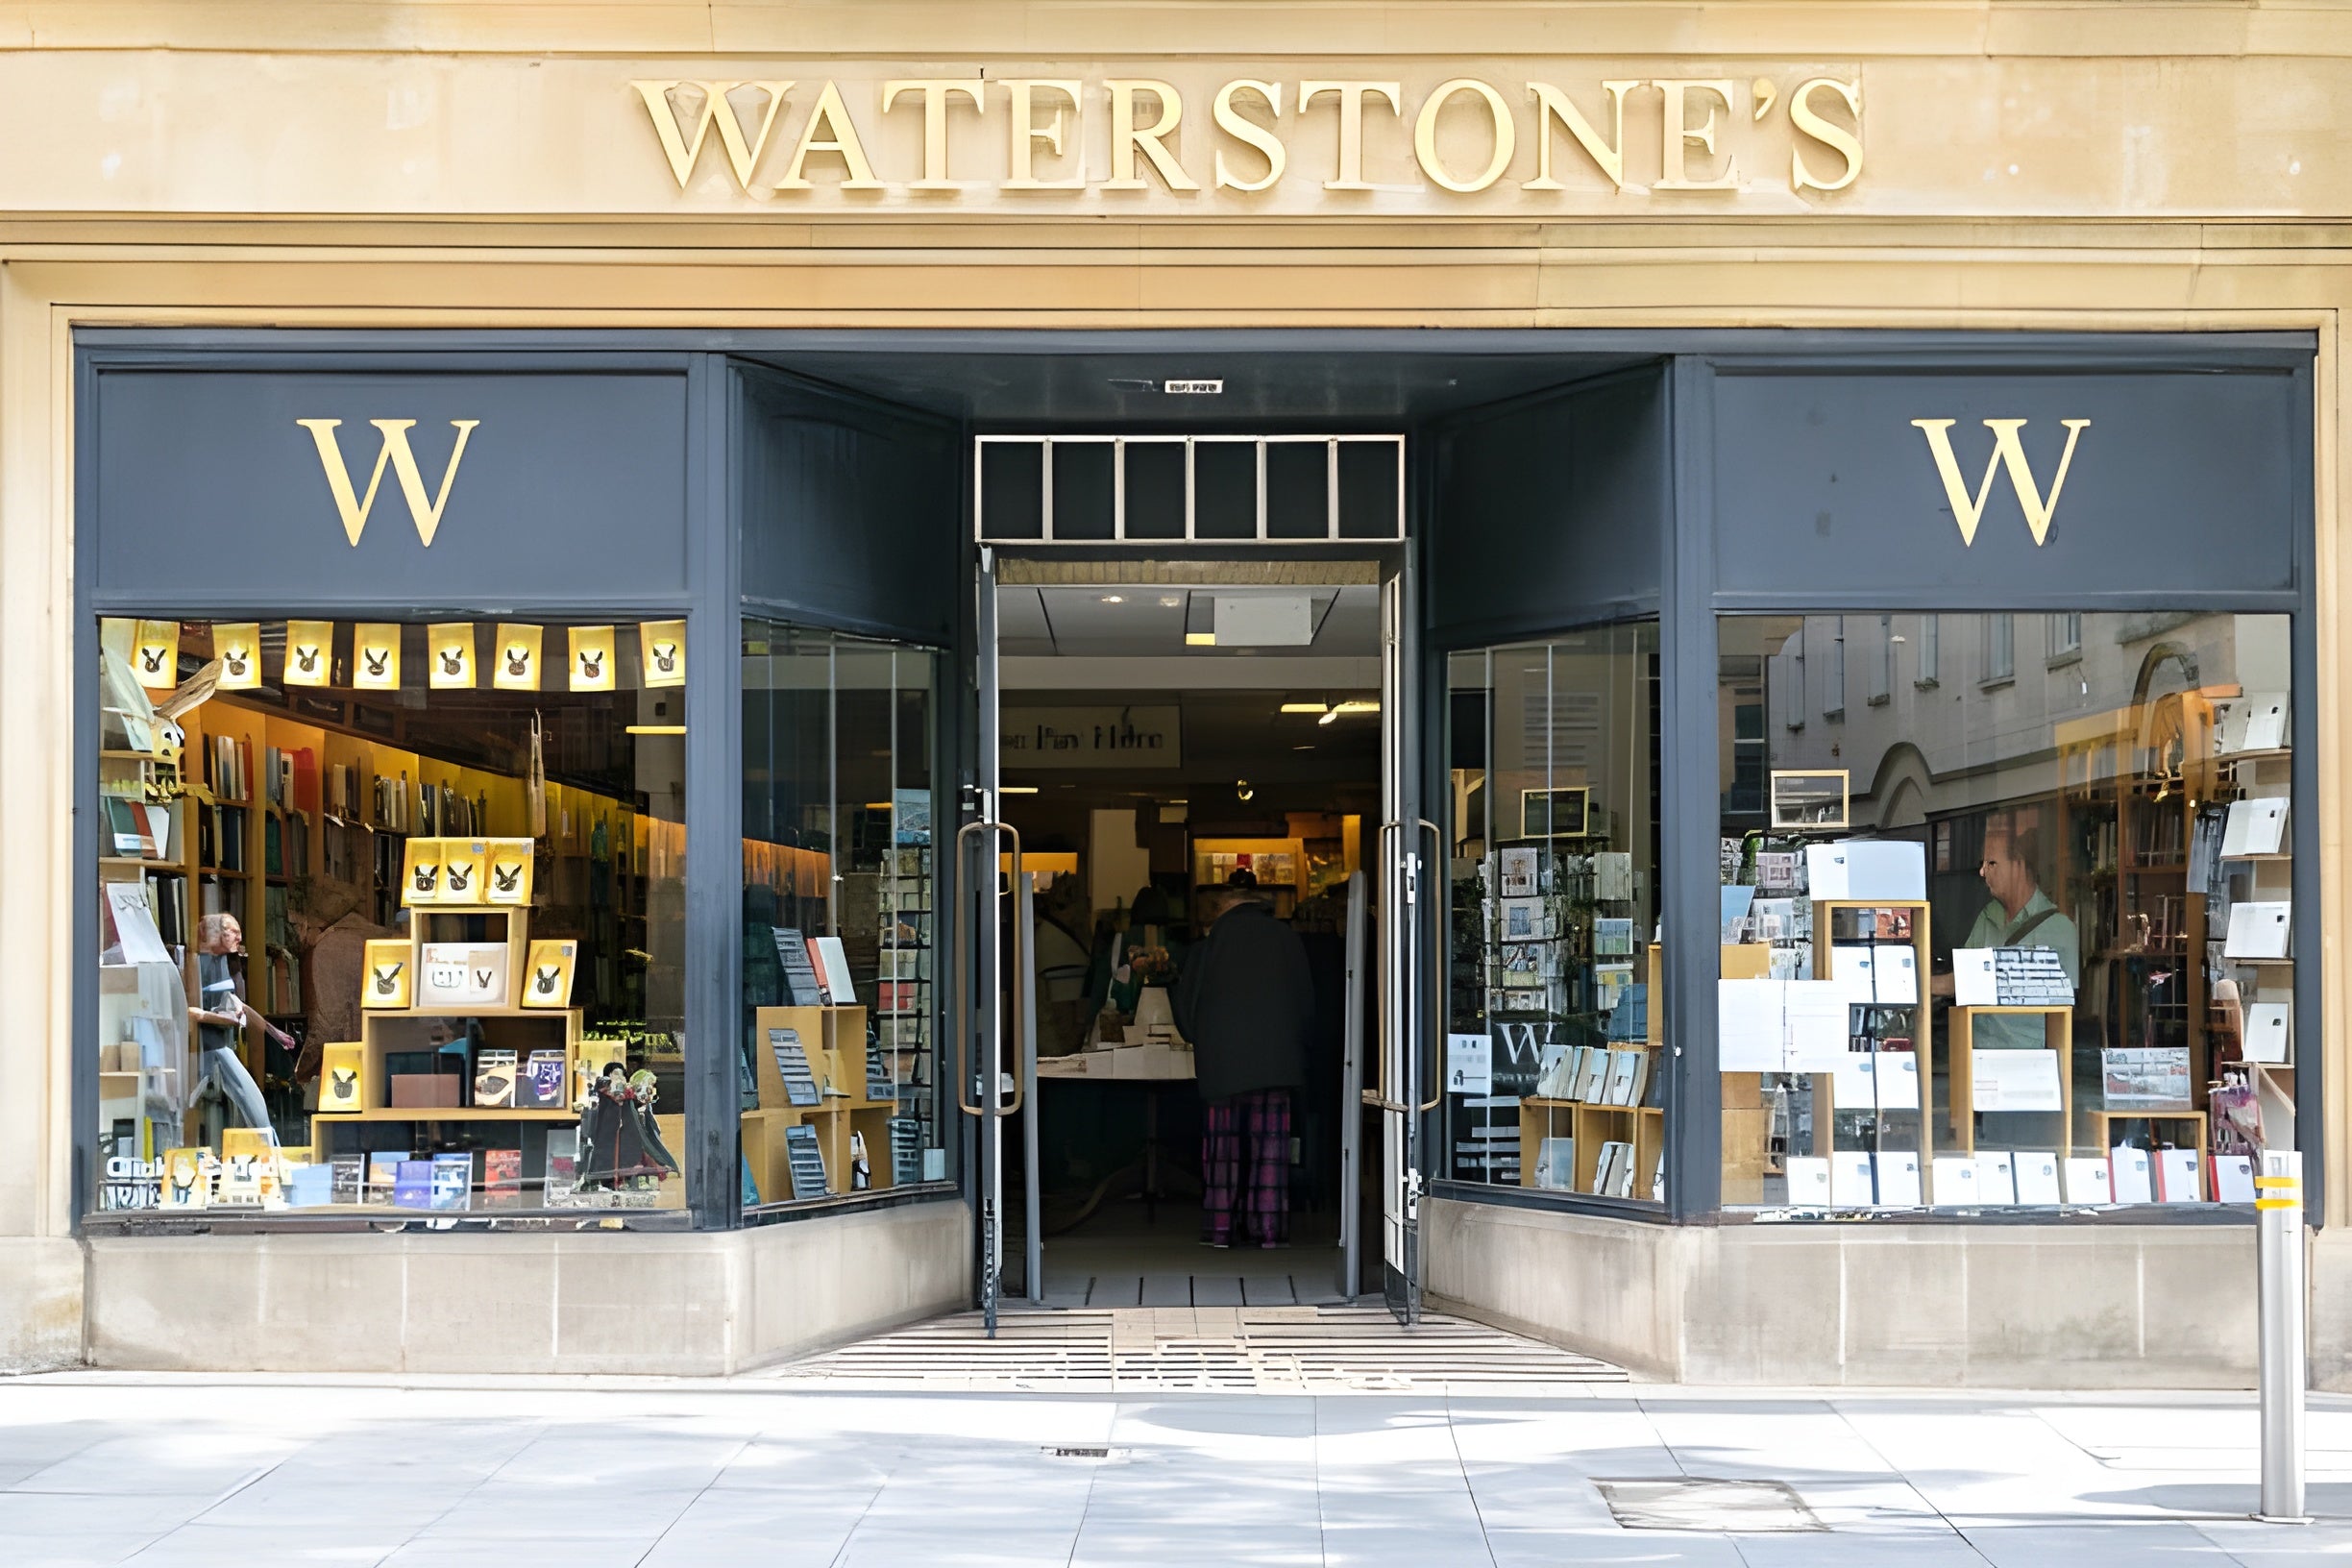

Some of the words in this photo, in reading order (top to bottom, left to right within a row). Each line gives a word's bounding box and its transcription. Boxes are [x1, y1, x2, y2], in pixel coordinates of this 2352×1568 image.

[632, 78, 1864, 193] WATERSTONE'S
[296, 419, 480, 548] W
[1910, 418, 2091, 547] W
